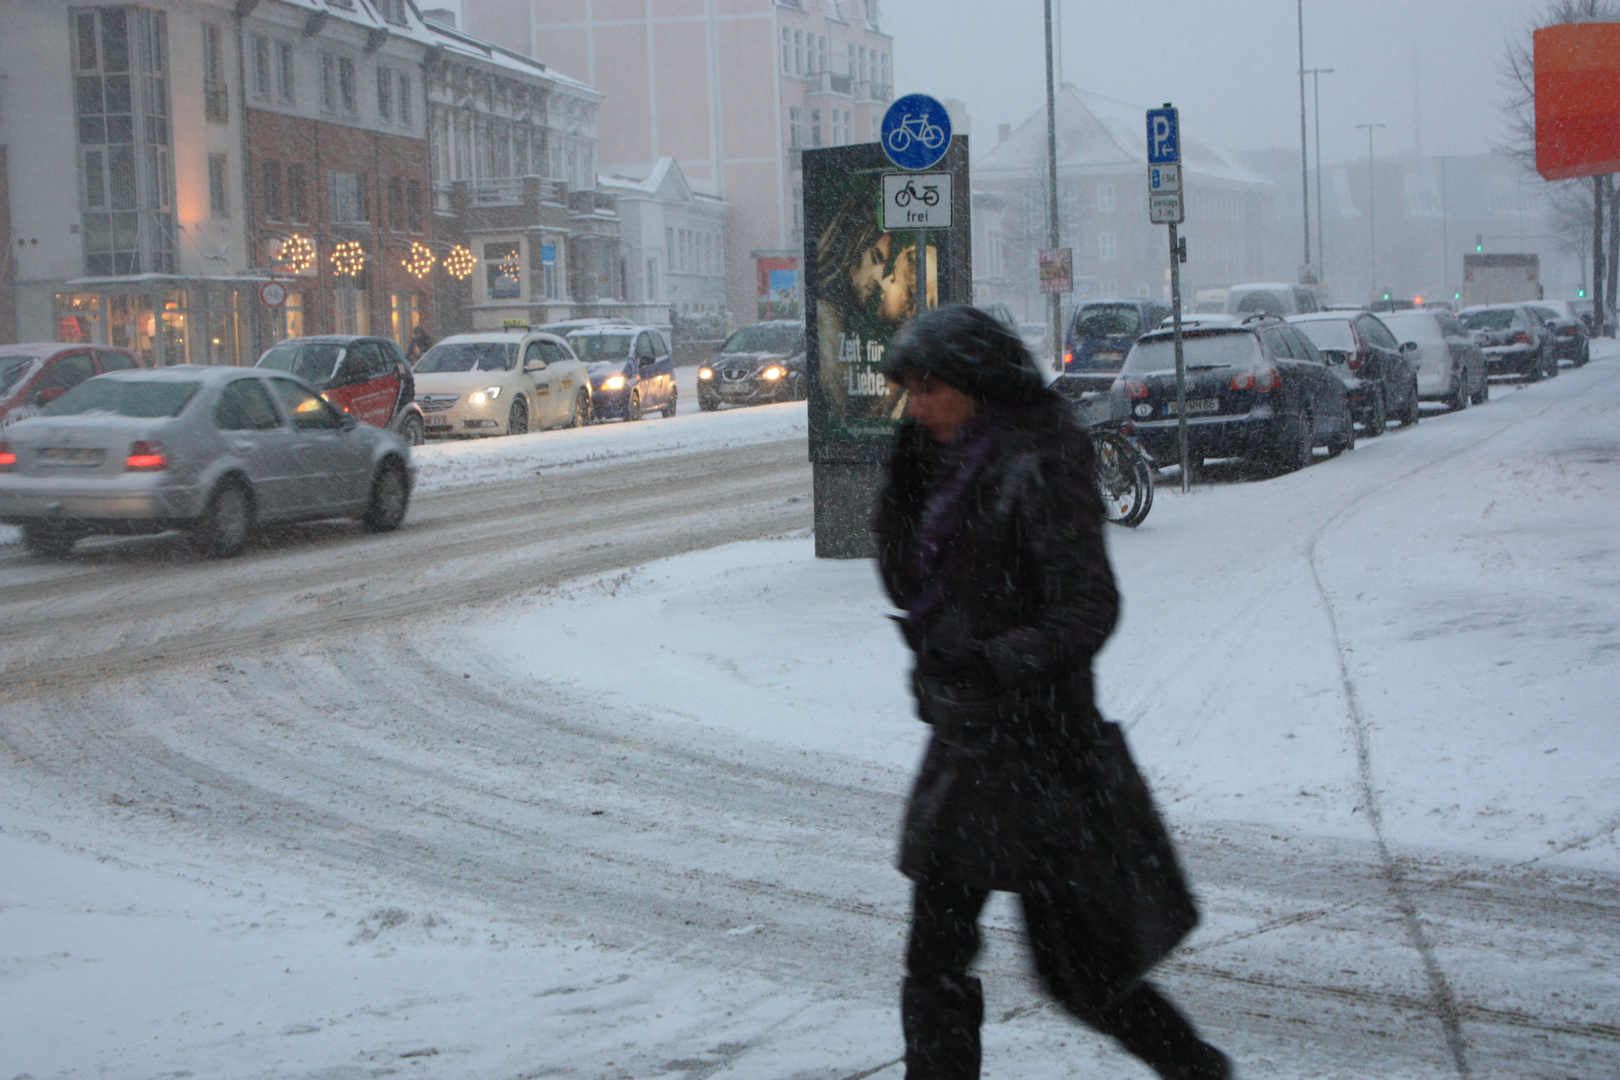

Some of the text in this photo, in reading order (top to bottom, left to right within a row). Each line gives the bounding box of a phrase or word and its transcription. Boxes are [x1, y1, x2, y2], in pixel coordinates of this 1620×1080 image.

[1153, 116, 1170, 158] P
[907, 210, 929, 223] frei
[838, 331, 885, 362] Zeit für
[848, 364, 891, 396] Liebe.
[1141, 405, 1147, 415] D
